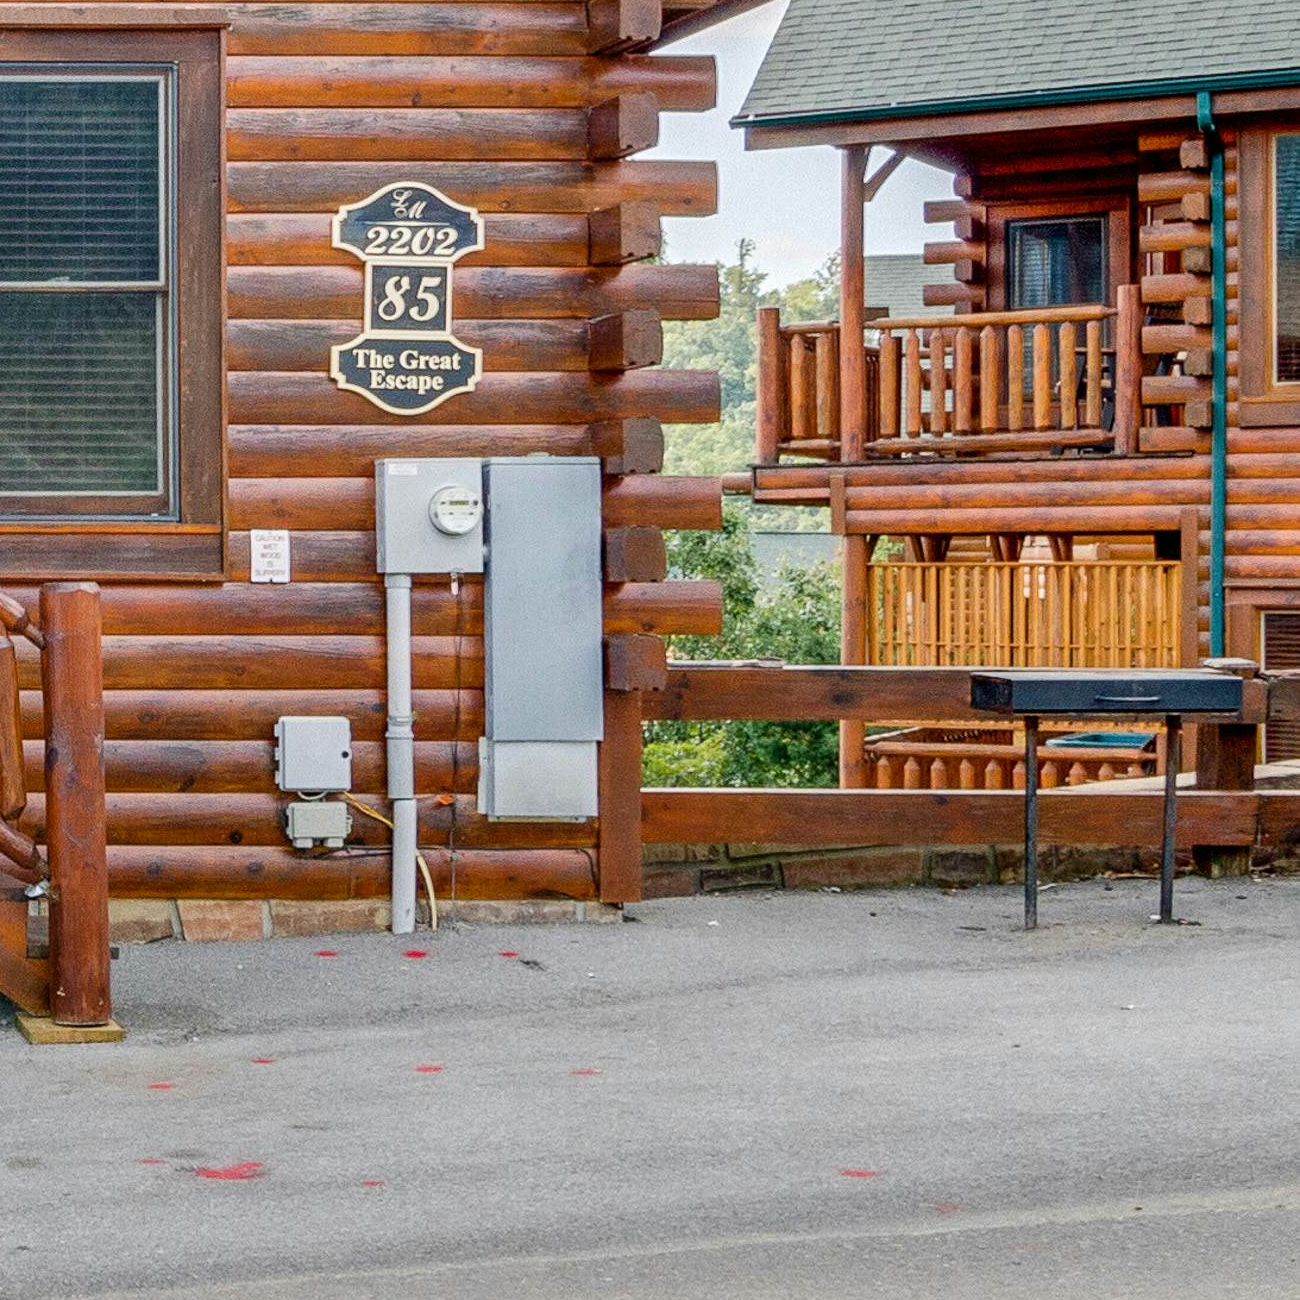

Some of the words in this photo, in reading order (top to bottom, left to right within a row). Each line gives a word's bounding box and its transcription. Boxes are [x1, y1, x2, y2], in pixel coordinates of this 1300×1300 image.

[364, 226, 458, 255] 2202
[377, 275, 442, 322] 85
[352, 348, 395, 369] The
[400, 349, 462, 370] Great
[370, 369, 444, 395] Escape
